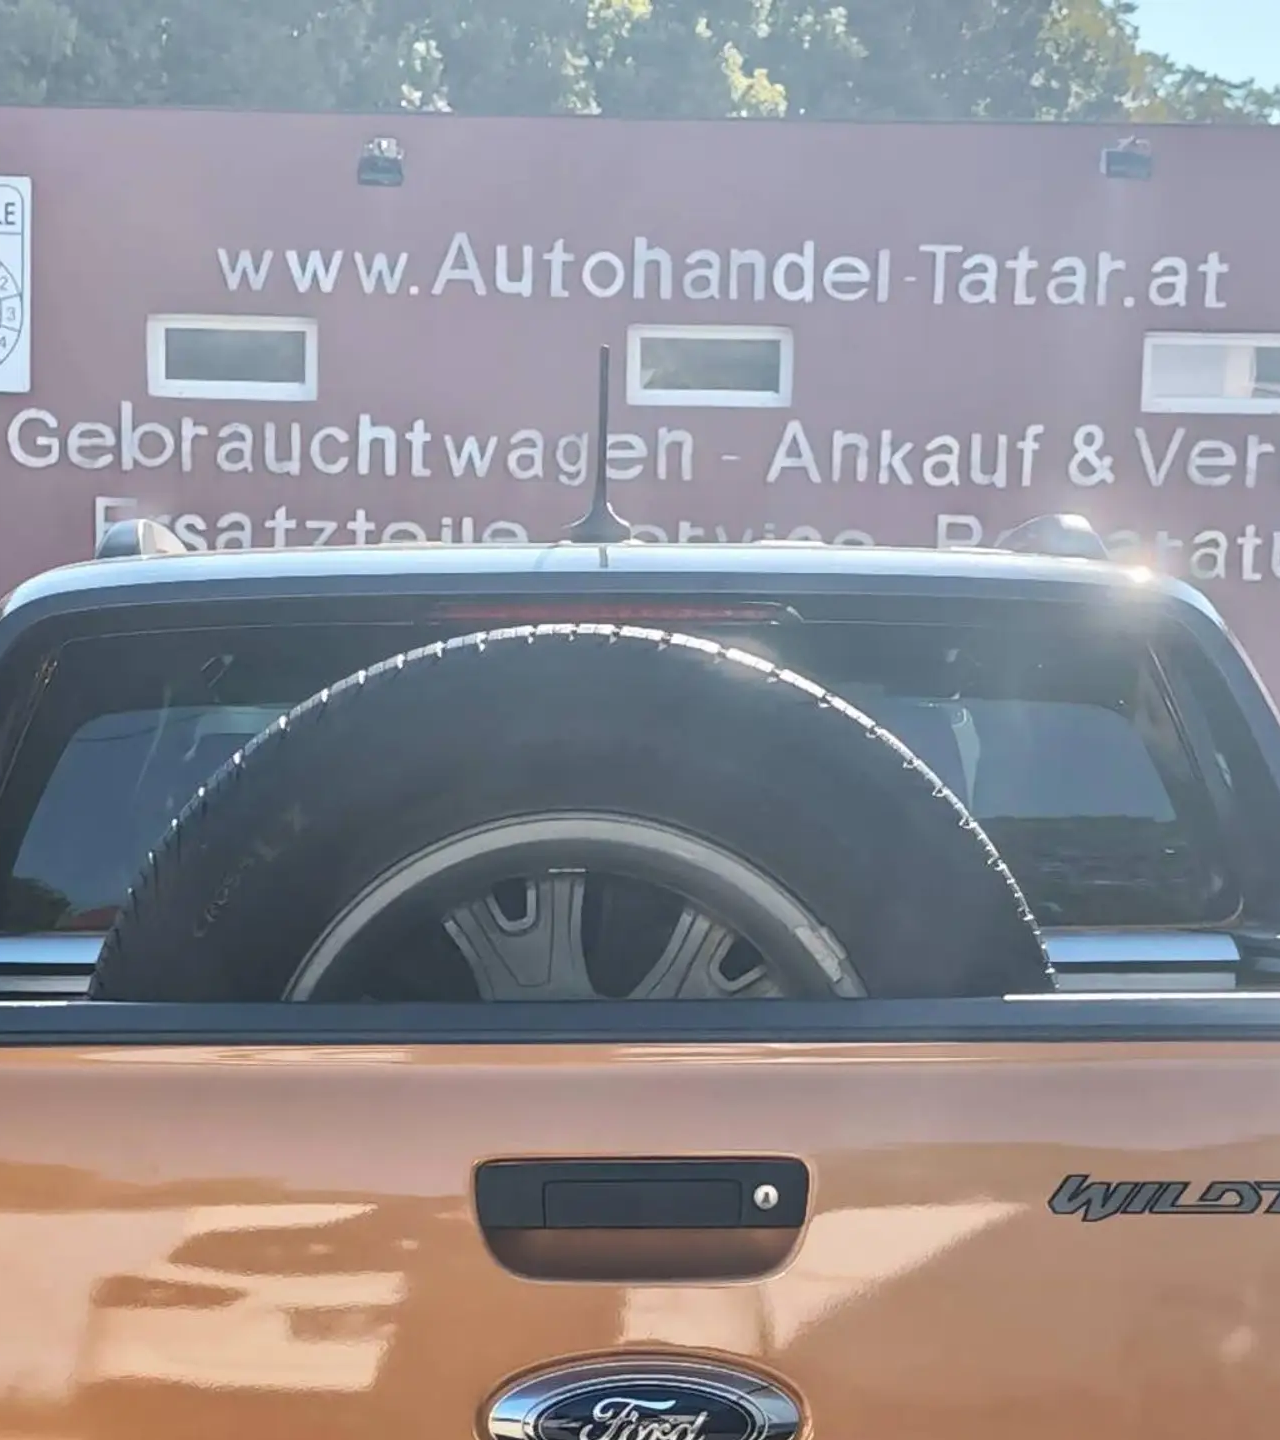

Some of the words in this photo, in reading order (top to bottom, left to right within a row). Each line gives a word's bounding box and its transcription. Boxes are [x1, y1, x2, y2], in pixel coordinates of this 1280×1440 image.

[0, 275, 10, 291] 2
[6, 306, 16, 322] 3
[5, 400, 694, 486] Gebrauchtwagen
[766, 418, 1044, 488] Ankauf
[1066, 423, 1116, 488] &
